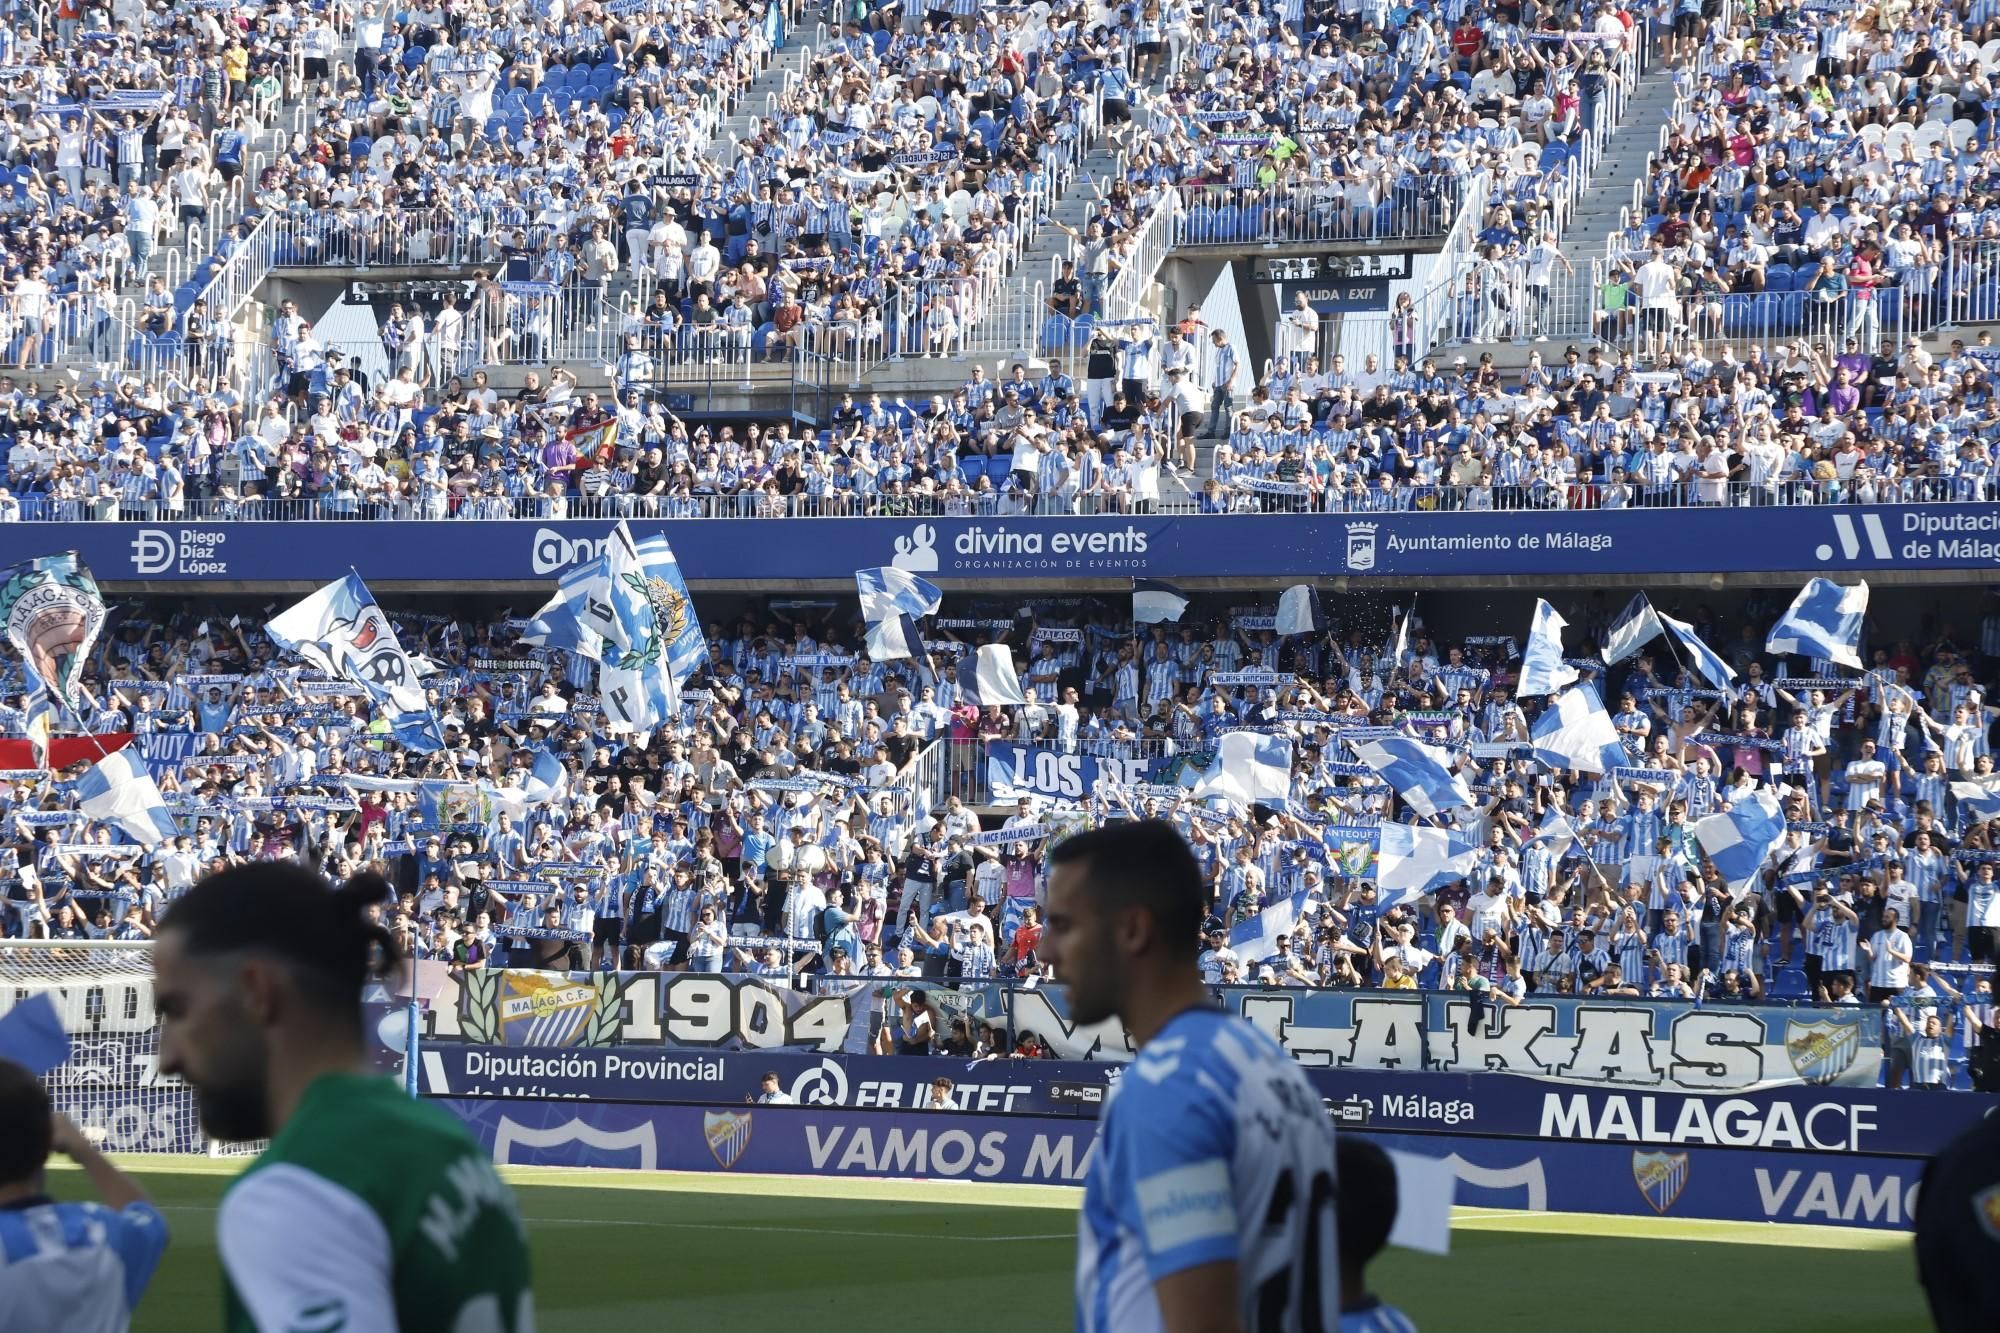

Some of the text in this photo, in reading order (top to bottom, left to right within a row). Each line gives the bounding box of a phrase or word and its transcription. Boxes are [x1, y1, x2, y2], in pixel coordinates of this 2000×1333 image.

[1348, 288, 1376, 300] EXIT
[1903, 511, 2000, 536] Diputaci
[180, 530, 226, 546] Diego
[955, 526, 1148, 554] divina events
[1386, 532, 1613, 553] Ayuntamiento de Málaga
[180, 544, 215, 559] Díaz
[1902, 540, 1932, 559] de
[179, 559, 227, 575] López
[955, 558, 1147, 569] ORGANIZACIÓN DE EVENTOS
[148, 735, 188, 761] MUY
[1012, 747, 1084, 797] LOS
[1616, 769, 1654, 780] MALAGA
[22, 813, 67, 823] MALAGA
[1000, 827, 1036, 842] MALAGA
[1325, 829, 1381, 840] ANTEQUER
[511, 989, 588, 1013] MALAGA C.F.
[620, 973, 850, 1054] 1904
[466, 1052, 724, 1082] Diputación Provincial
[1382, 1095, 1475, 1125] Málaga
[805, 1125, 1008, 1177] VAMOS
[1754, 1168, 1916, 1224] VAM
